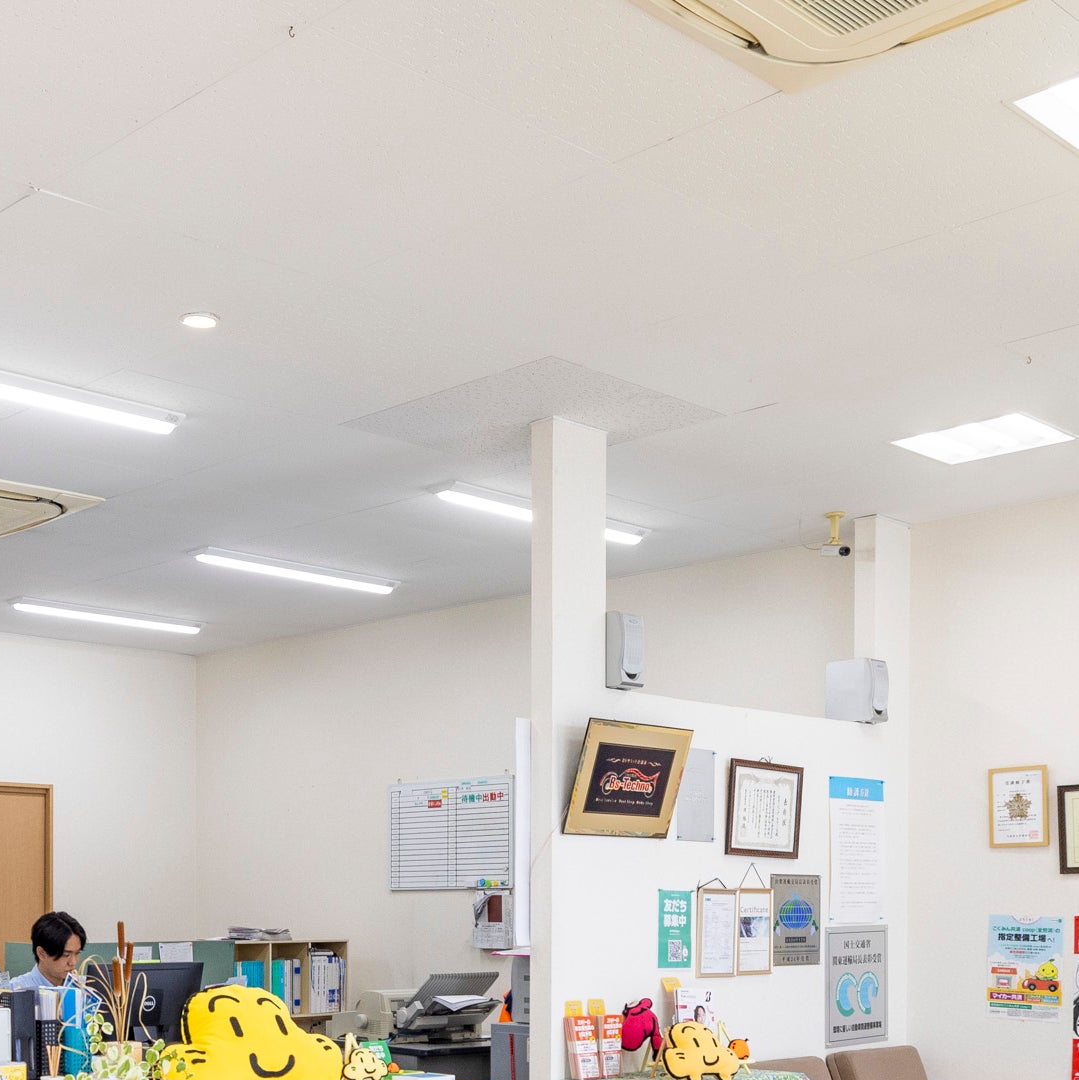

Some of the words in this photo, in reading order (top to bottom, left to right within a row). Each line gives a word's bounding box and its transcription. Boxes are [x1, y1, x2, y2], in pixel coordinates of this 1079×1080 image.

[482, 791, 504, 802] 出動中
[663, 899, 687, 913] 友だち
[740, 905, 769, 914] Certificate
[663, 914, 687, 928] 募集中
[843, 939, 872, 950] 国土交通省
